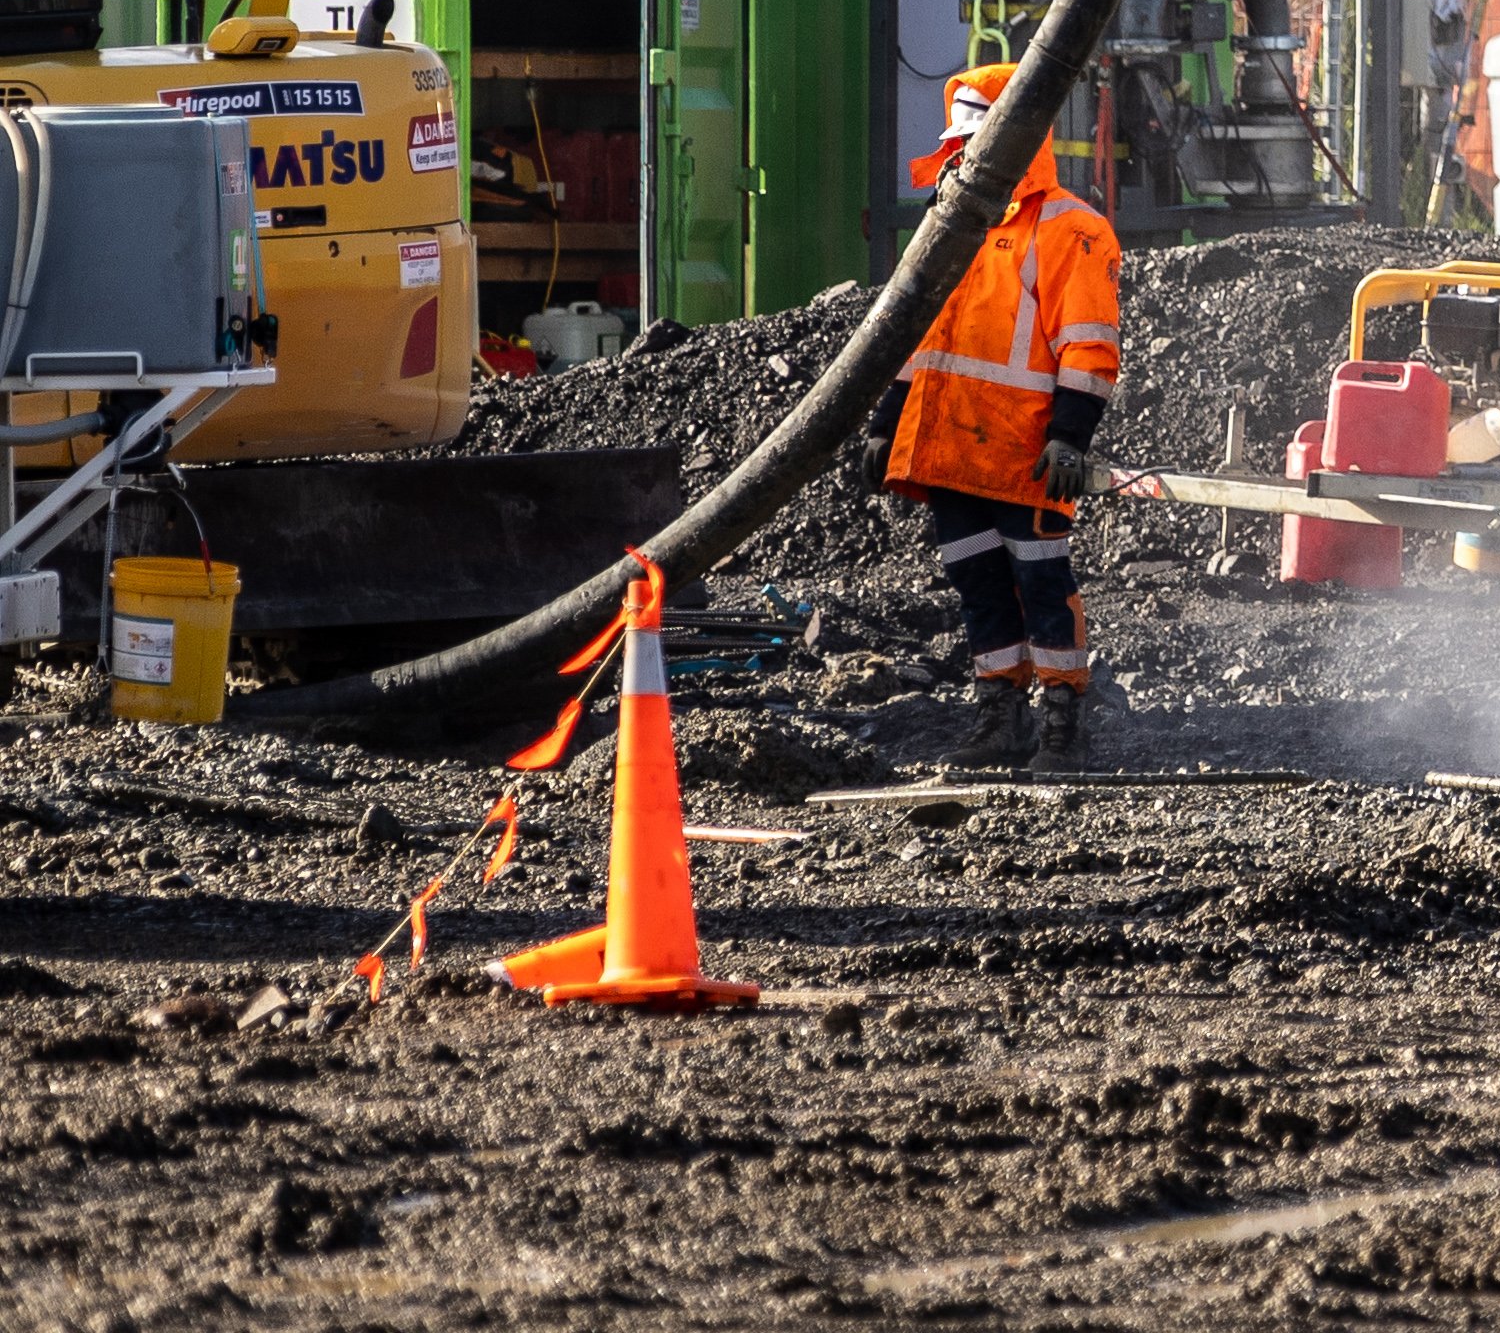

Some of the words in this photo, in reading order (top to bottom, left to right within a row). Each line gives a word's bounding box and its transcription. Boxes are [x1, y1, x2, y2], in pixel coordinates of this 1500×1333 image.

[175, 91, 261, 115] Hirepool
[293, 89, 312, 106] 15
[315, 89, 332, 106] 15
[335, 89, 351, 106] 15
